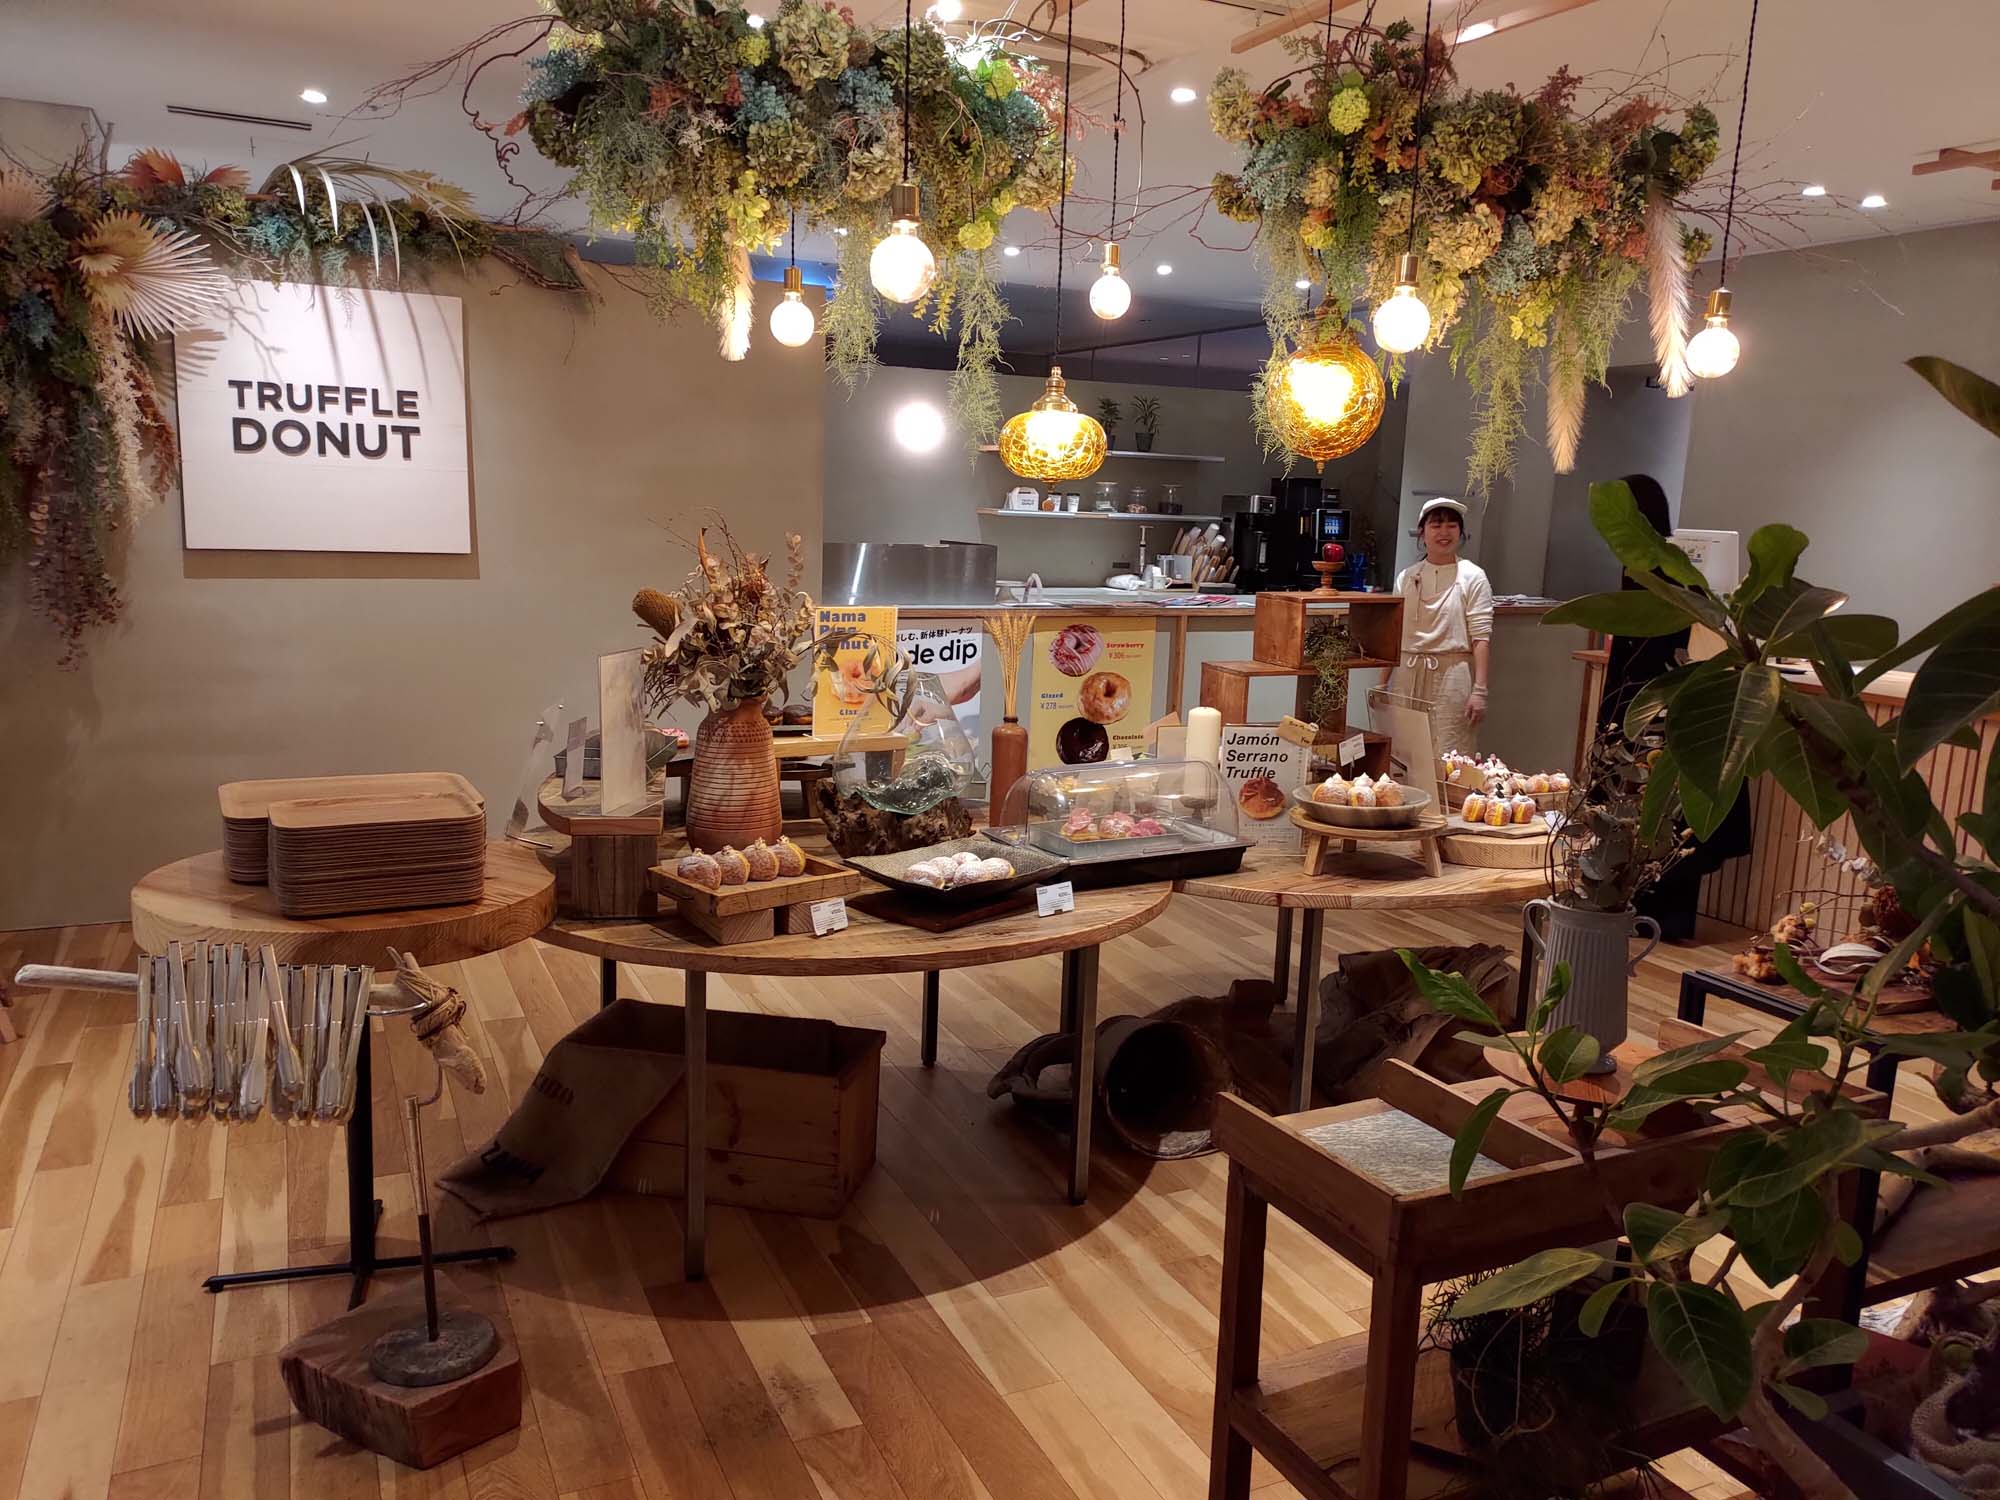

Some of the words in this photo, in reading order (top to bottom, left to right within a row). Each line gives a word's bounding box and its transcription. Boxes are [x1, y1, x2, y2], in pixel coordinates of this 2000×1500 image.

[228, 380, 419, 419] TRUFFLE
[232, 416, 420, 461] DONUT
[820, 611, 866, 622] Nama
[939, 639, 978, 665] dip
[1226, 733, 1280, 746] Jamón
[1226, 750, 1289, 763] Serrano
[1226, 766, 1276, 779] Truffle
